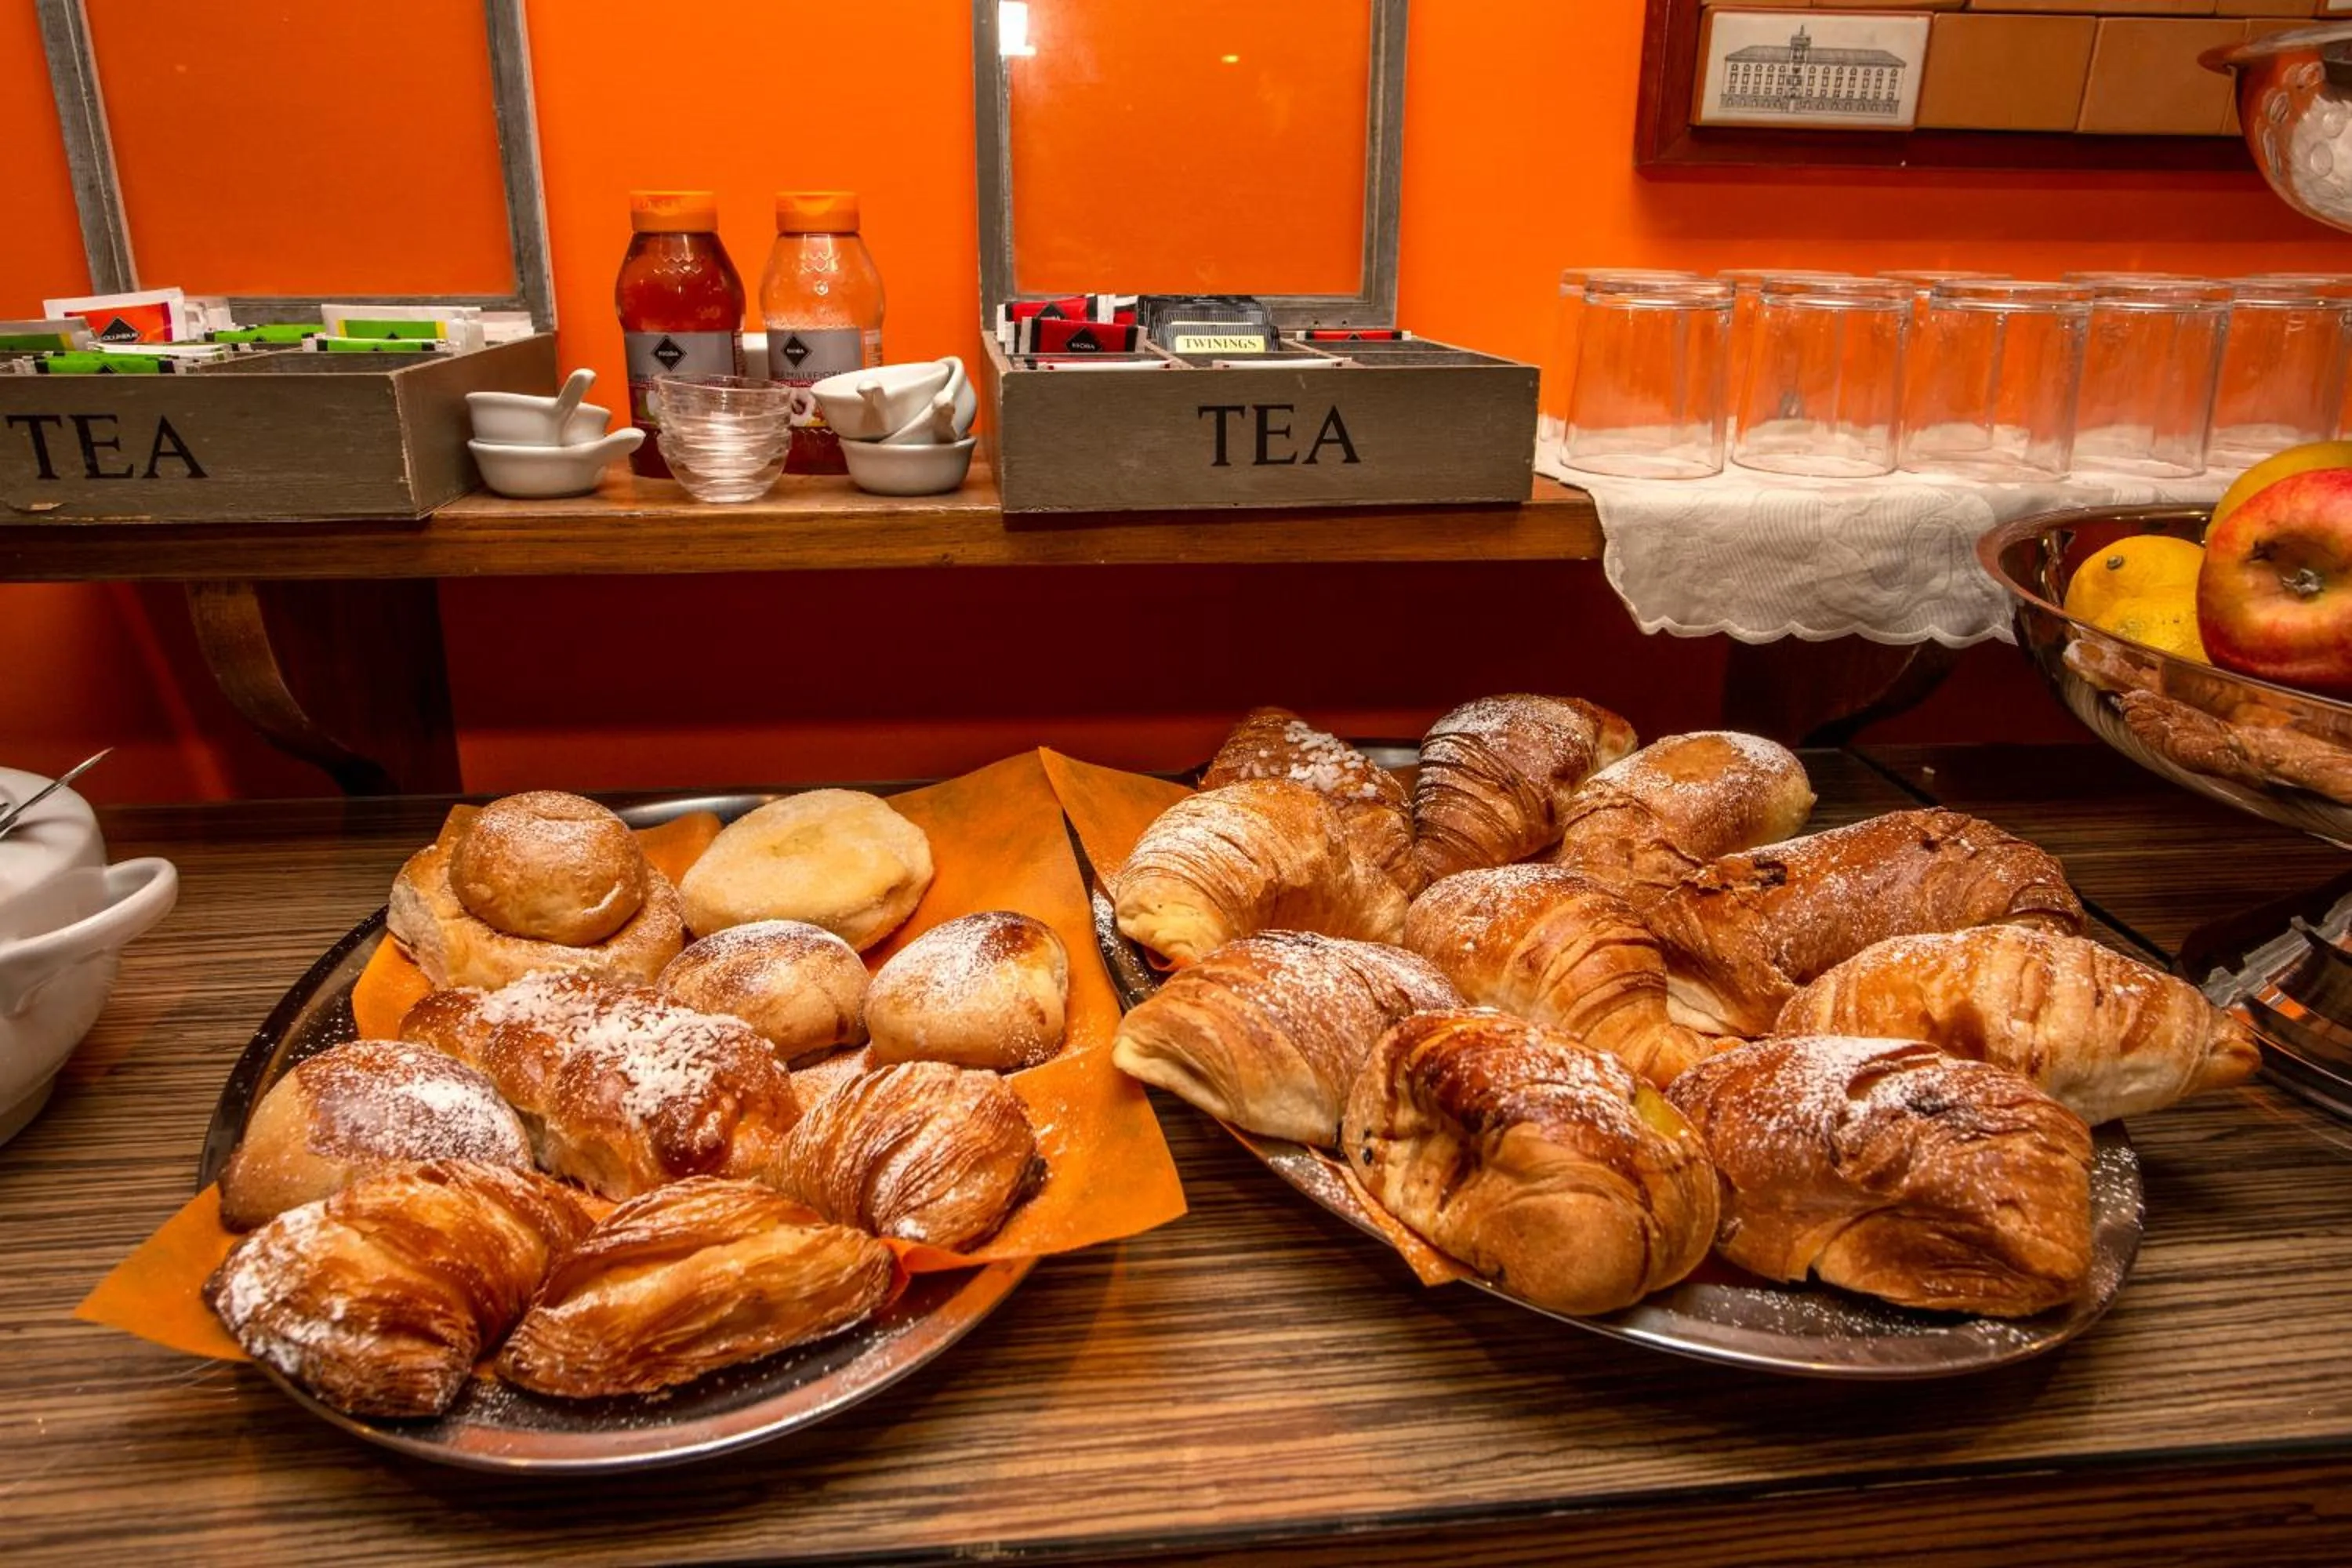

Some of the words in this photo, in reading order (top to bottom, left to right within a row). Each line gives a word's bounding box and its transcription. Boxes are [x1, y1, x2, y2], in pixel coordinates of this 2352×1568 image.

[1184, 338, 1257, 349] TWININGS
[5, 414, 209, 480] TEA
[1197, 404, 1361, 466] TEA
